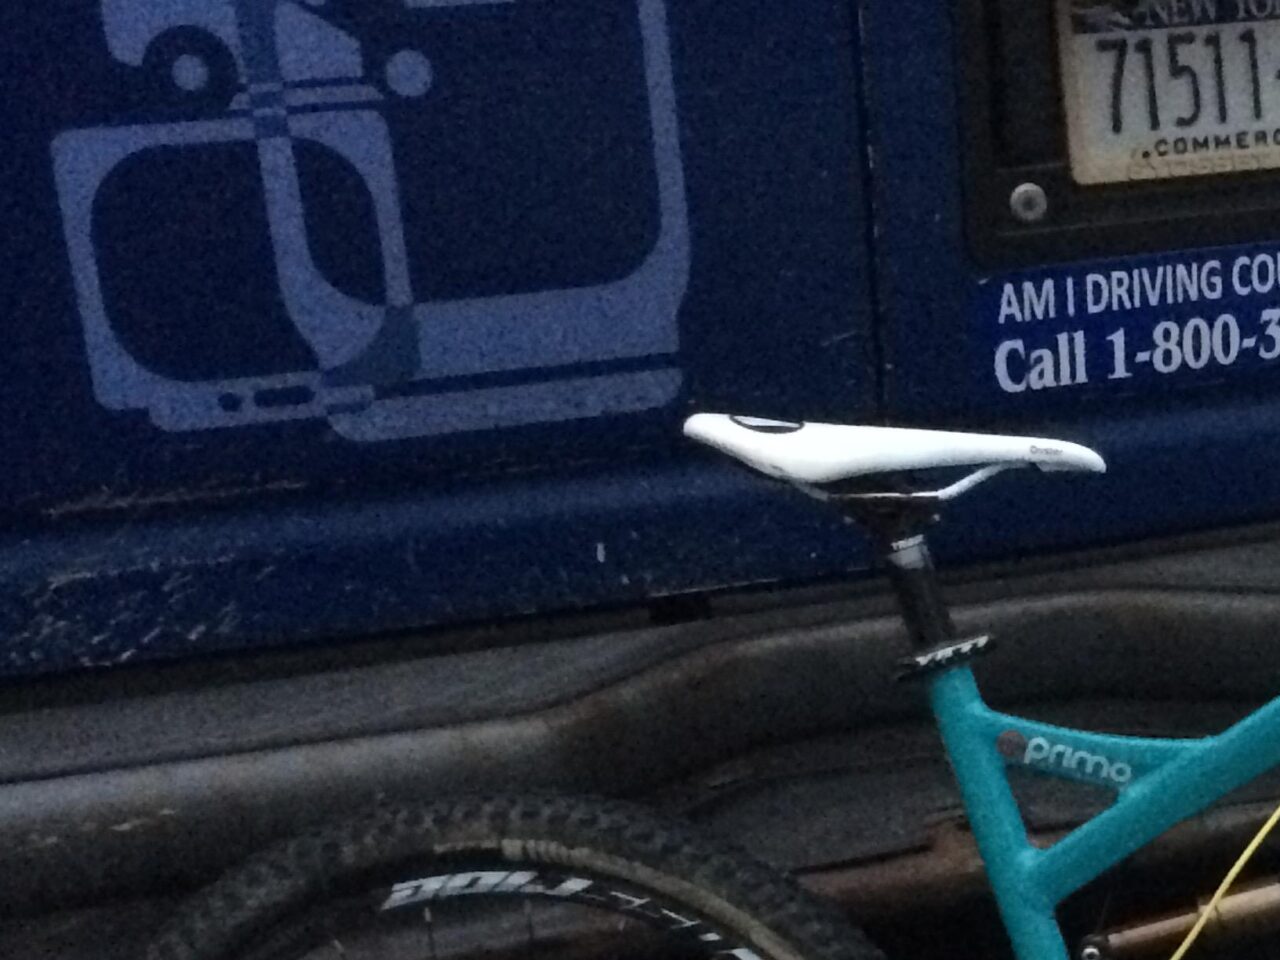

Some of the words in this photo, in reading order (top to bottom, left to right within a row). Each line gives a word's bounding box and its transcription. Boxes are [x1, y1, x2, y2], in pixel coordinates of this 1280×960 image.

[1095, 28, 1262, 134] 71511
[998, 278, 1056, 324] AM
[1066, 276, 1075, 318] I
[1086, 260, 1223, 315] DRIVING
[994, 330, 1088, 393] Call
